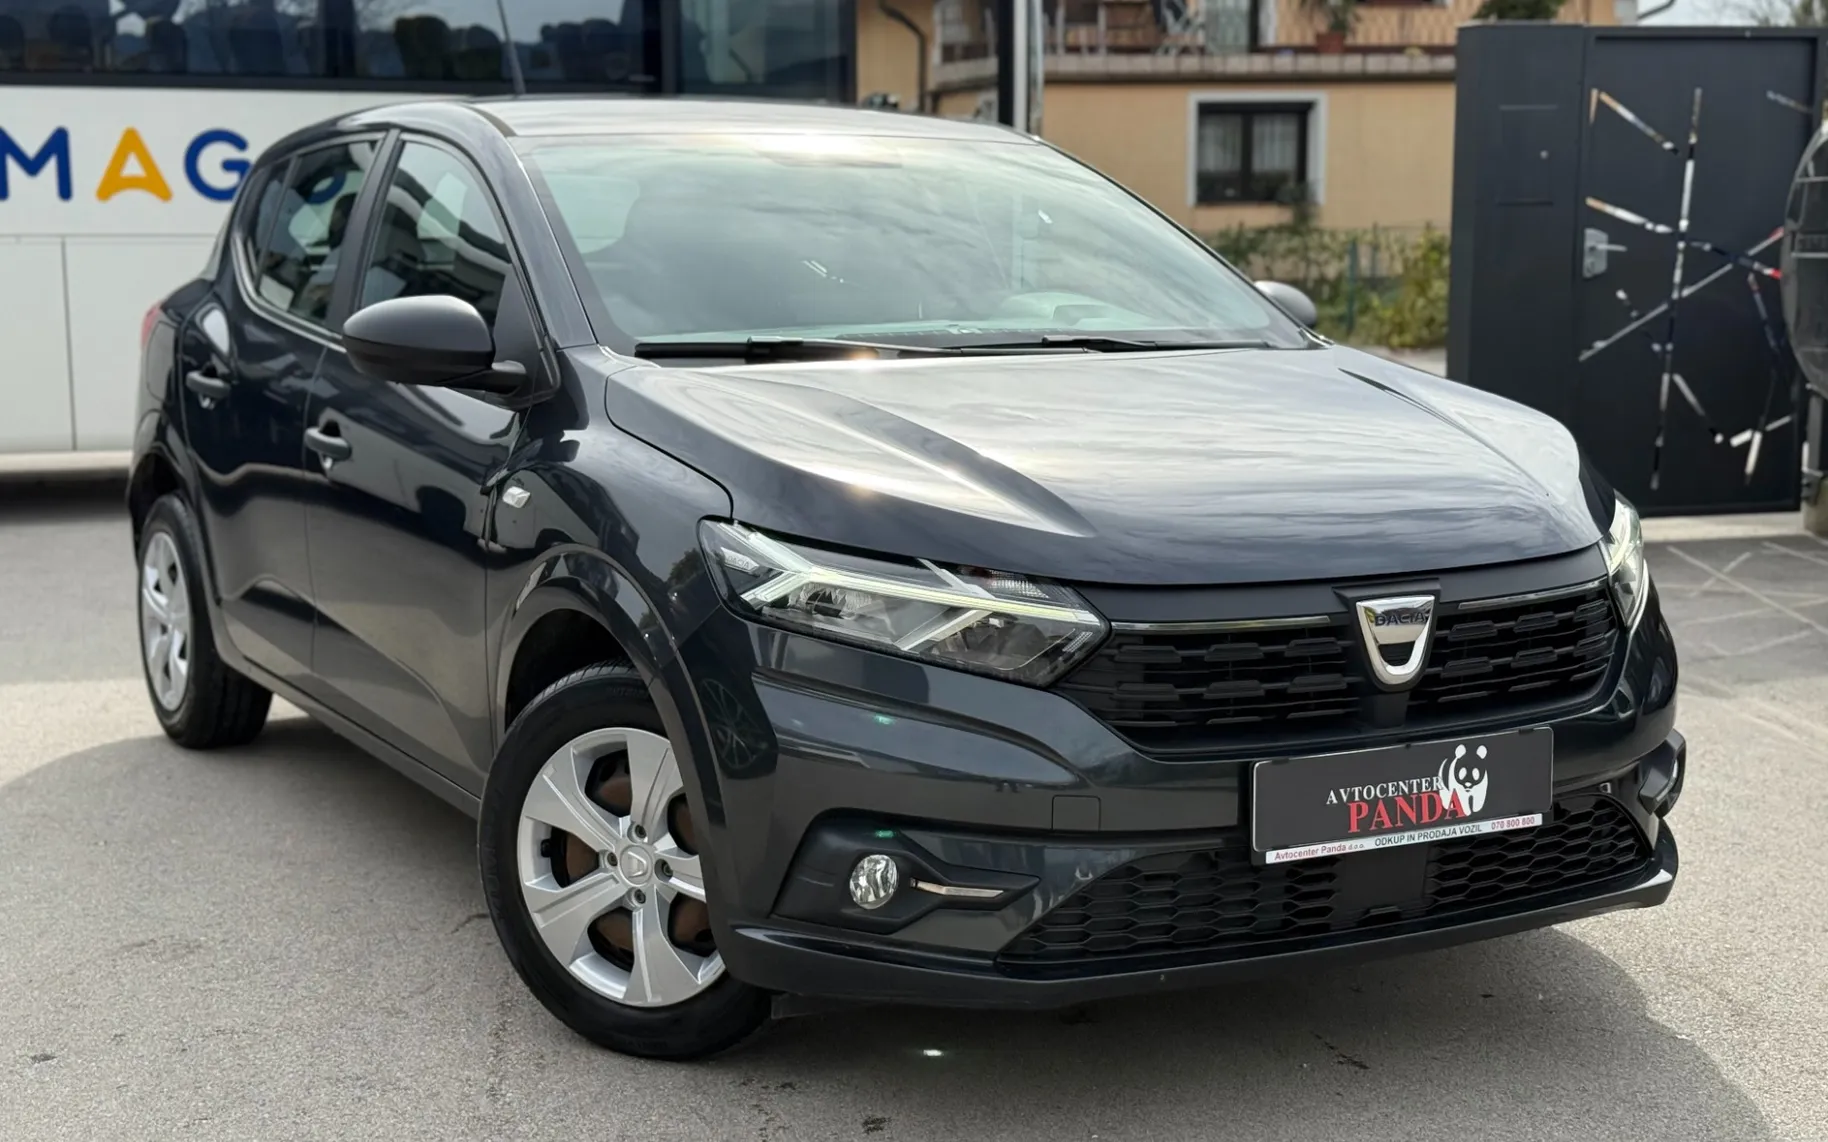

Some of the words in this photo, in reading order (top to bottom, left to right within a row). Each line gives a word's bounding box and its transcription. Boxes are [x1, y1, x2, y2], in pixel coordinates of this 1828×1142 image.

[1375, 611, 1425, 626] DACIA
[1326, 776, 1444, 805] AVTOCENTER
[1348, 788, 1467, 833] PANDA
[1274, 848, 1319, 861] Avtocenter
[1321, 844, 1347, 854] Panda
[1374, 834, 1405, 847] ODKUP
[1406, 833, 1416, 842] IN
[1417, 826, 1457, 841] PRODAJA
[1459, 824, 1482, 835] VOZIL
